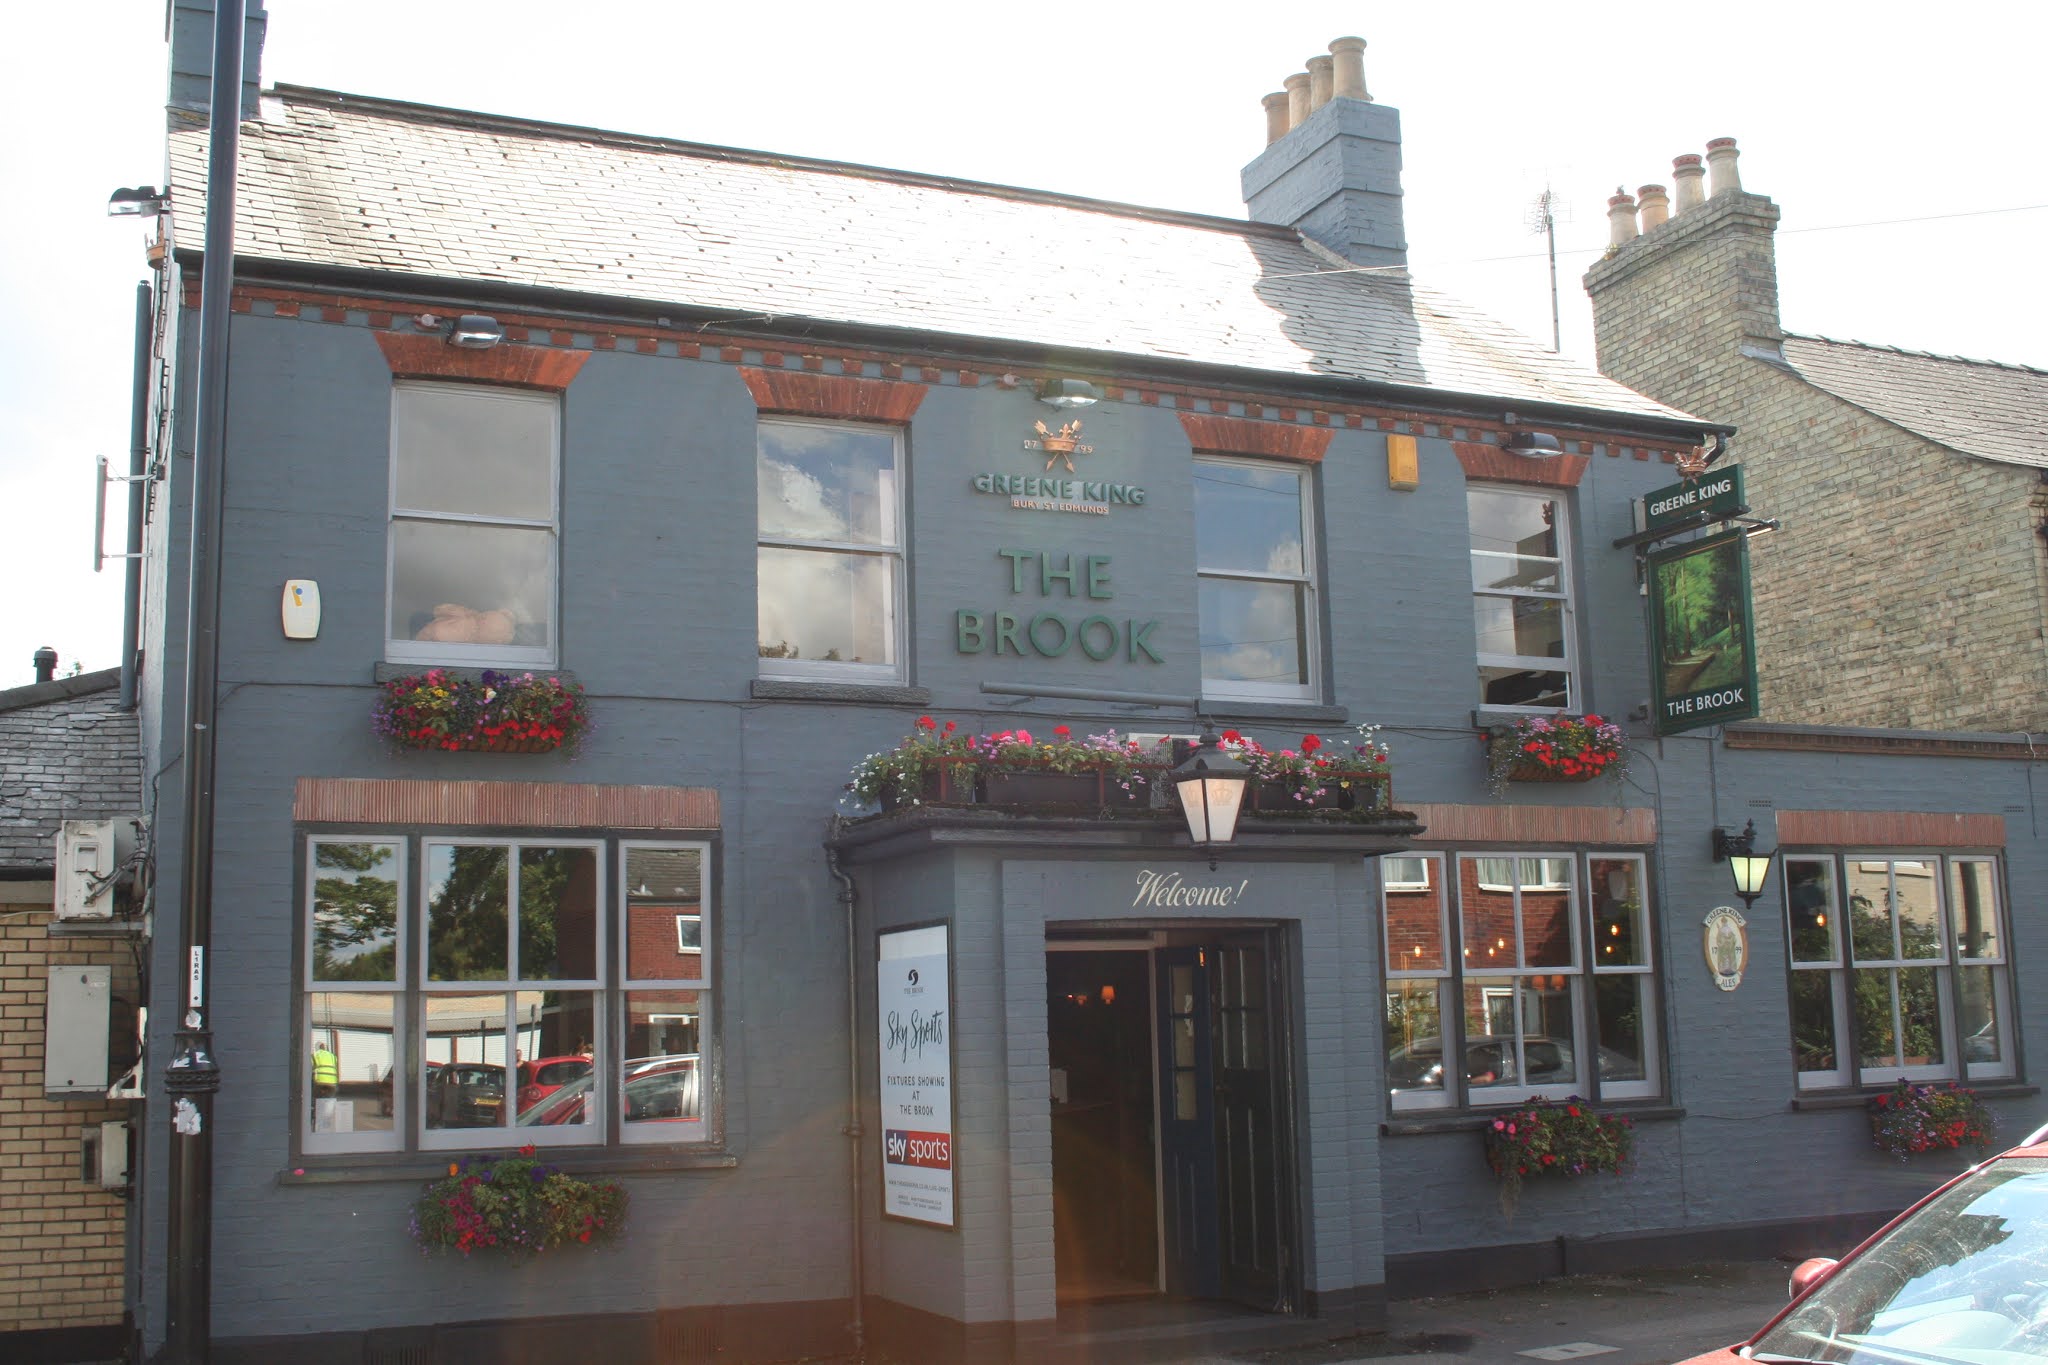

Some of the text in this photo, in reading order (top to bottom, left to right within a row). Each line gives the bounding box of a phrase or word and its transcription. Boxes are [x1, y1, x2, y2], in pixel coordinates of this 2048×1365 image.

[1080, 445, 1093, 454] 99
[972, 472, 1145, 505] GREENE KING
[1650, 479, 1731, 516] GREENE KING
[1012, 498, 1109, 515] BURY ST EDMUNDS
[998, 548, 1113, 600] THE
[957, 609, 1166, 664] BROOK
[1667, 688, 1744, 716] THE BROOK
[1132, 869, 1249, 907] Welcome!
[1706, 907, 1743, 925] GREENE KING
[1711, 946, 1718, 955] 17
[1721, 978, 1736, 988] ALES
[887, 1008, 944, 1064] Sky Sports
[887, 1075, 945, 1087] FIXTURES SHOWING
[911, 1090, 921, 1101] AT
[900, 1104, 934, 1116] THE BROOK
[888, 1132, 948, 1164] sky sports
